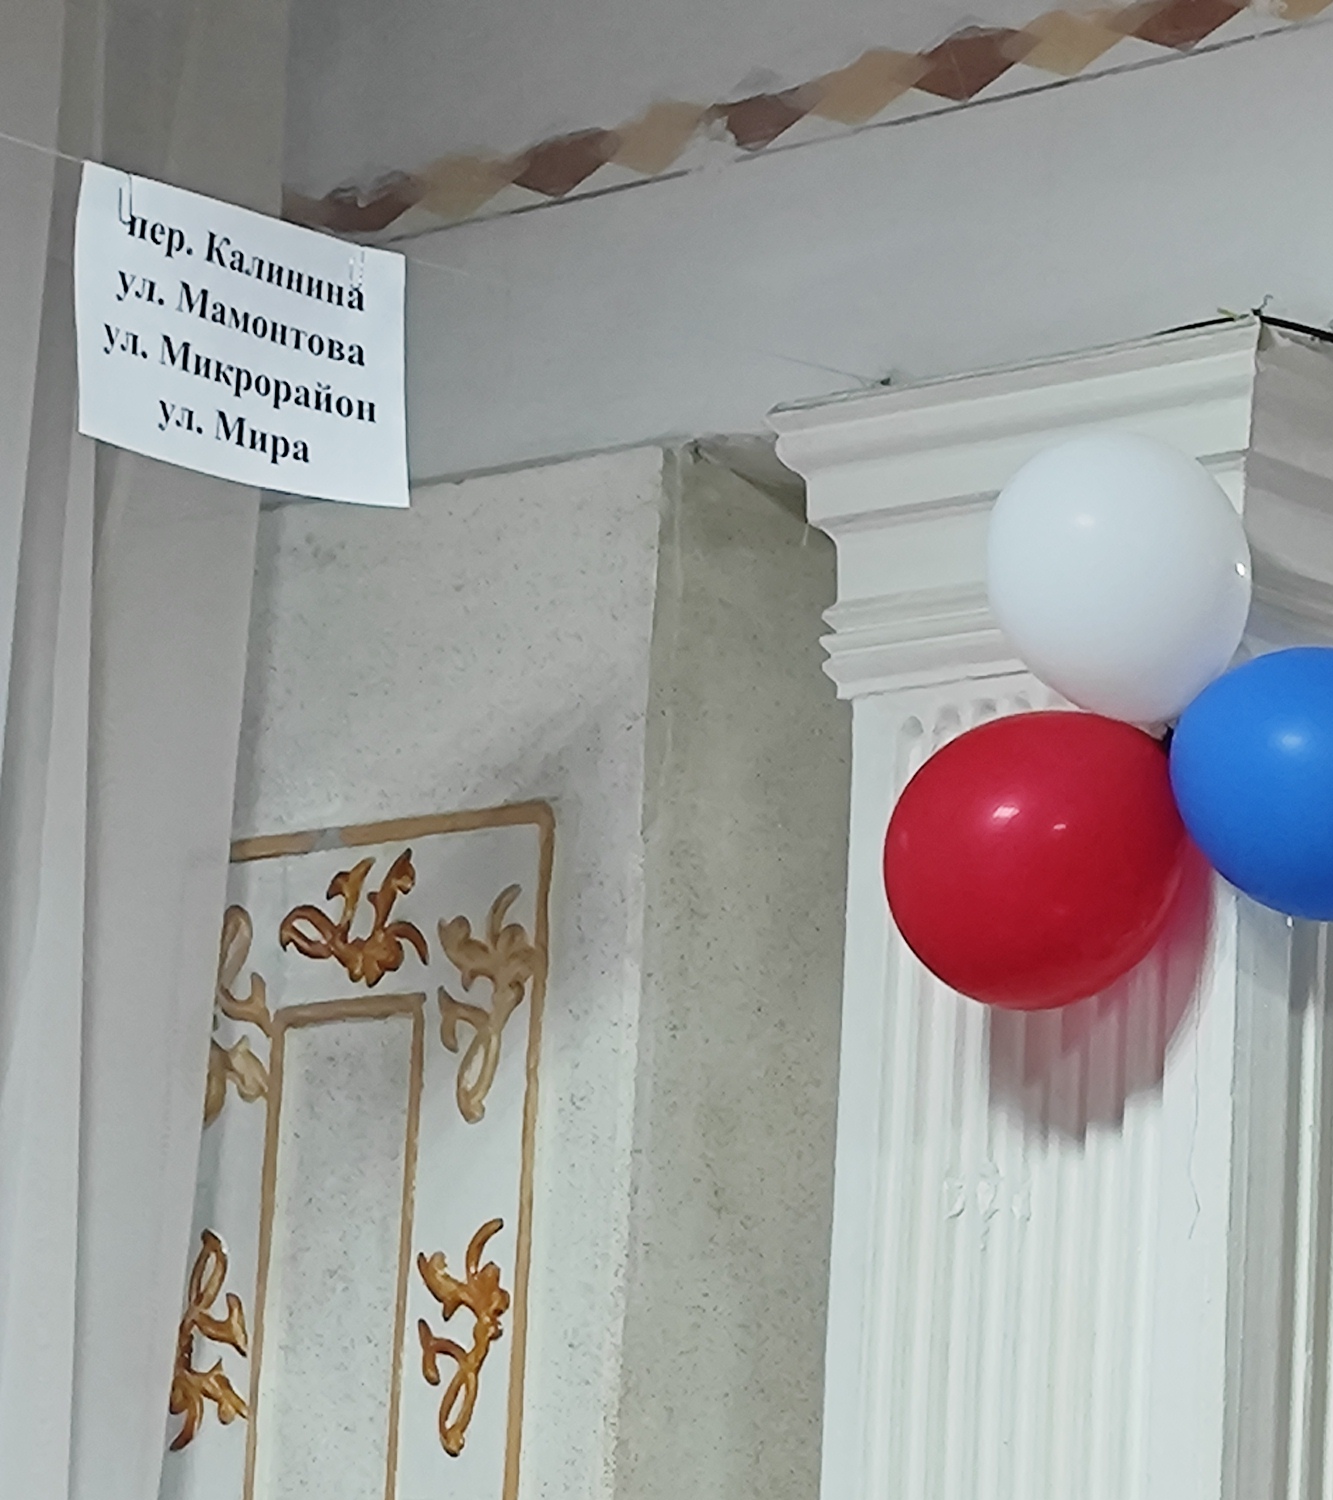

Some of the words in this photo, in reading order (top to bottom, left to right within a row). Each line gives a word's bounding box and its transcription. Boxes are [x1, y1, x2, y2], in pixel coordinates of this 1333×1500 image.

[127, 213, 192, 255] пер.
[206, 230, 364, 311] Калинина
[115, 269, 164, 306] ул.
[177, 280, 364, 366] Мамонтова
[103, 321, 147, 359] ул.
[159, 333, 377, 423] Микрорайон
[157, 398, 202, 435] ул.
[215, 409, 310, 465] Мира
